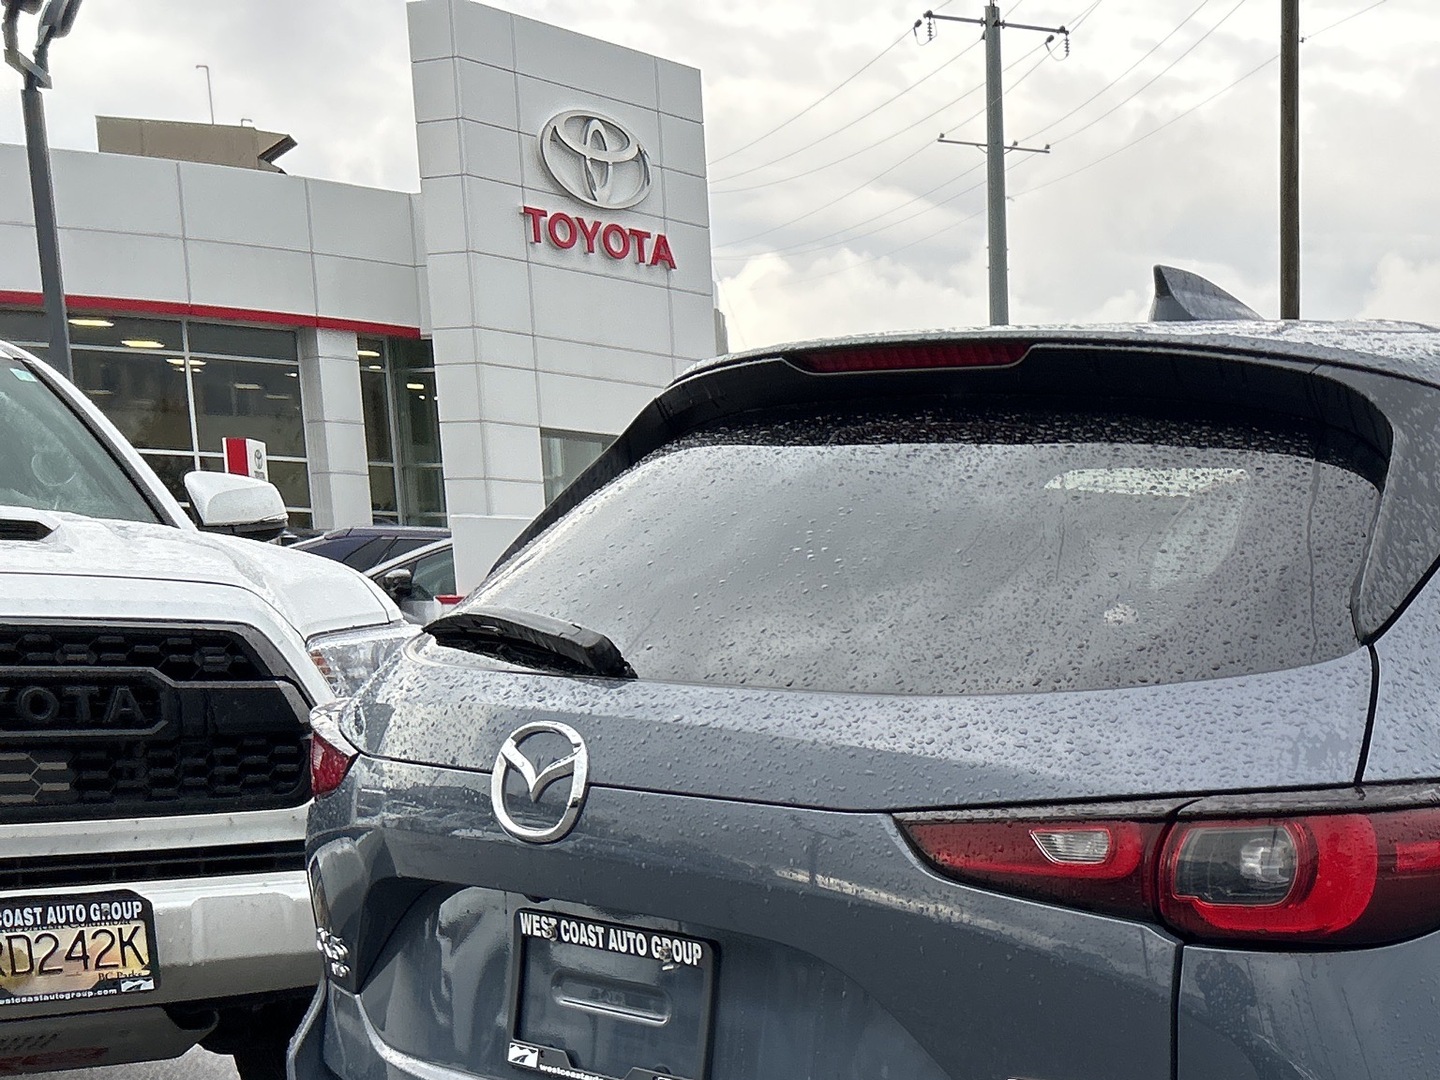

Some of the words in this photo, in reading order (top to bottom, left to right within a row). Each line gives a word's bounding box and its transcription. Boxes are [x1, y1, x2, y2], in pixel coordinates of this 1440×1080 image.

[521, 206, 678, 270] TOYOTA
[0, 685, 147, 723] OTA
[0, 907, 43, 928] OAST
[47, 904, 87, 924] AUTO
[90, 902, 143, 921] GROUP
[520, 912, 558, 939] WEST
[561, 919, 604, 949] COAST
[608, 929, 648, 956] AUTO
[651, 936, 702, 966] GROUP
[0, 926, 146, 977] D242K
